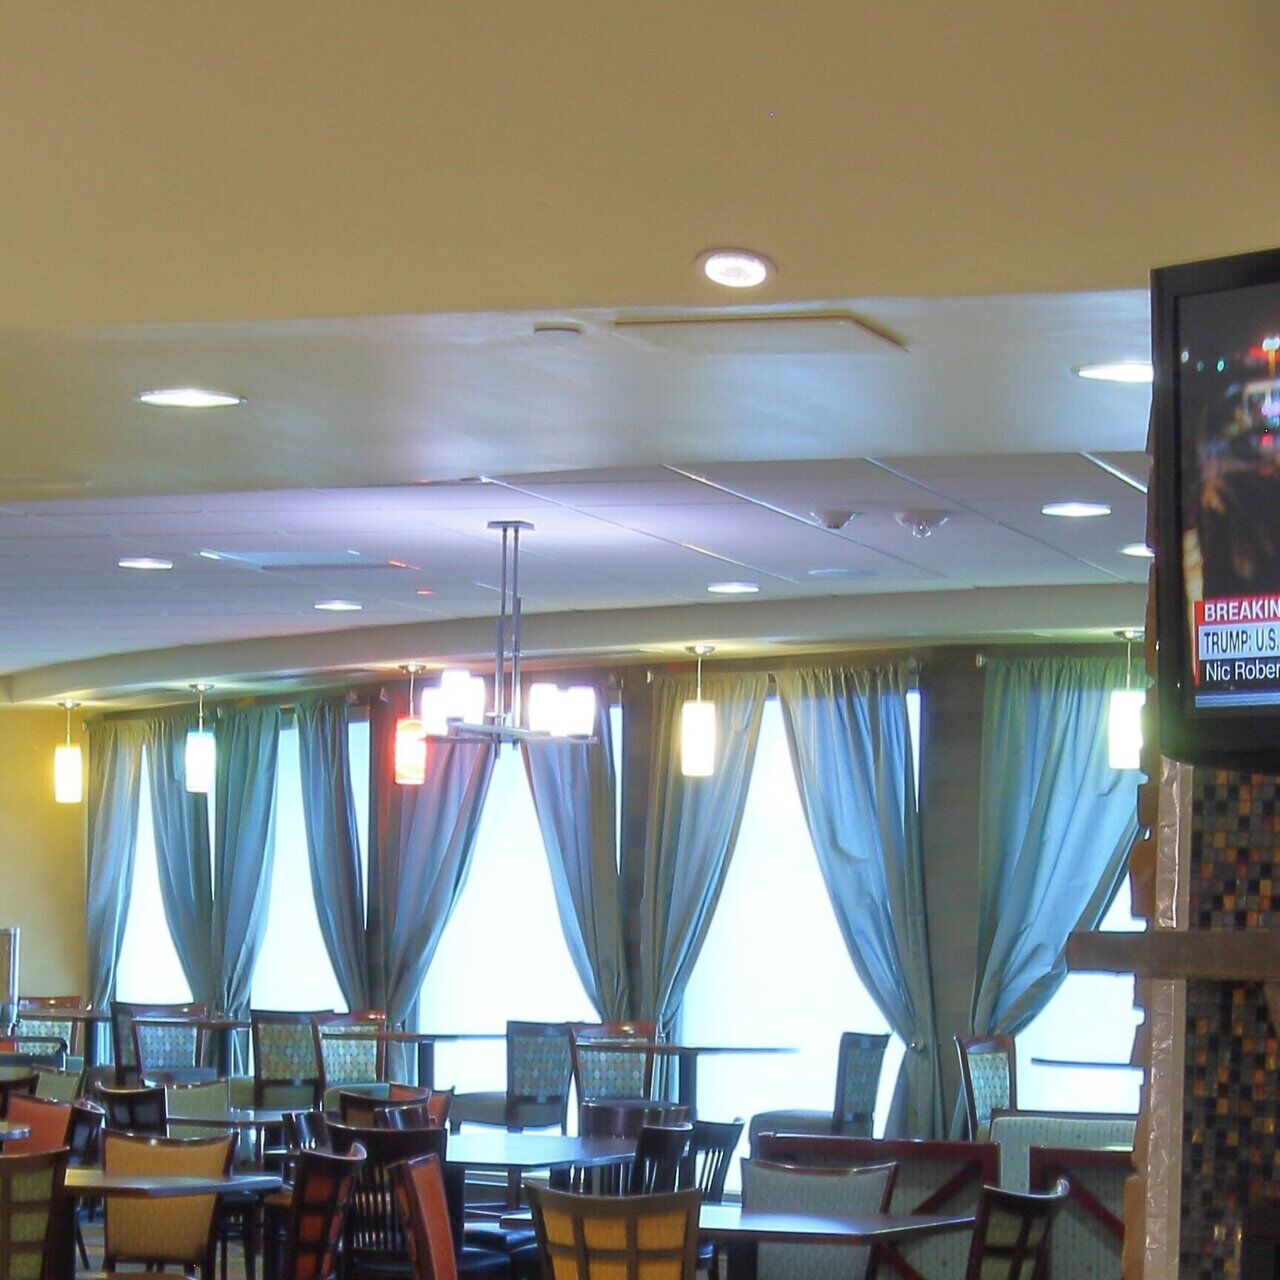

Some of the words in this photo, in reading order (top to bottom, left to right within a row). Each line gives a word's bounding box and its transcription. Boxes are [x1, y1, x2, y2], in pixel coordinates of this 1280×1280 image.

[1204, 629, 1252, 655] TRUMP:
[1256, 627, 1279, 651] U.S.
[1206, 661, 1230, 681] Nic
